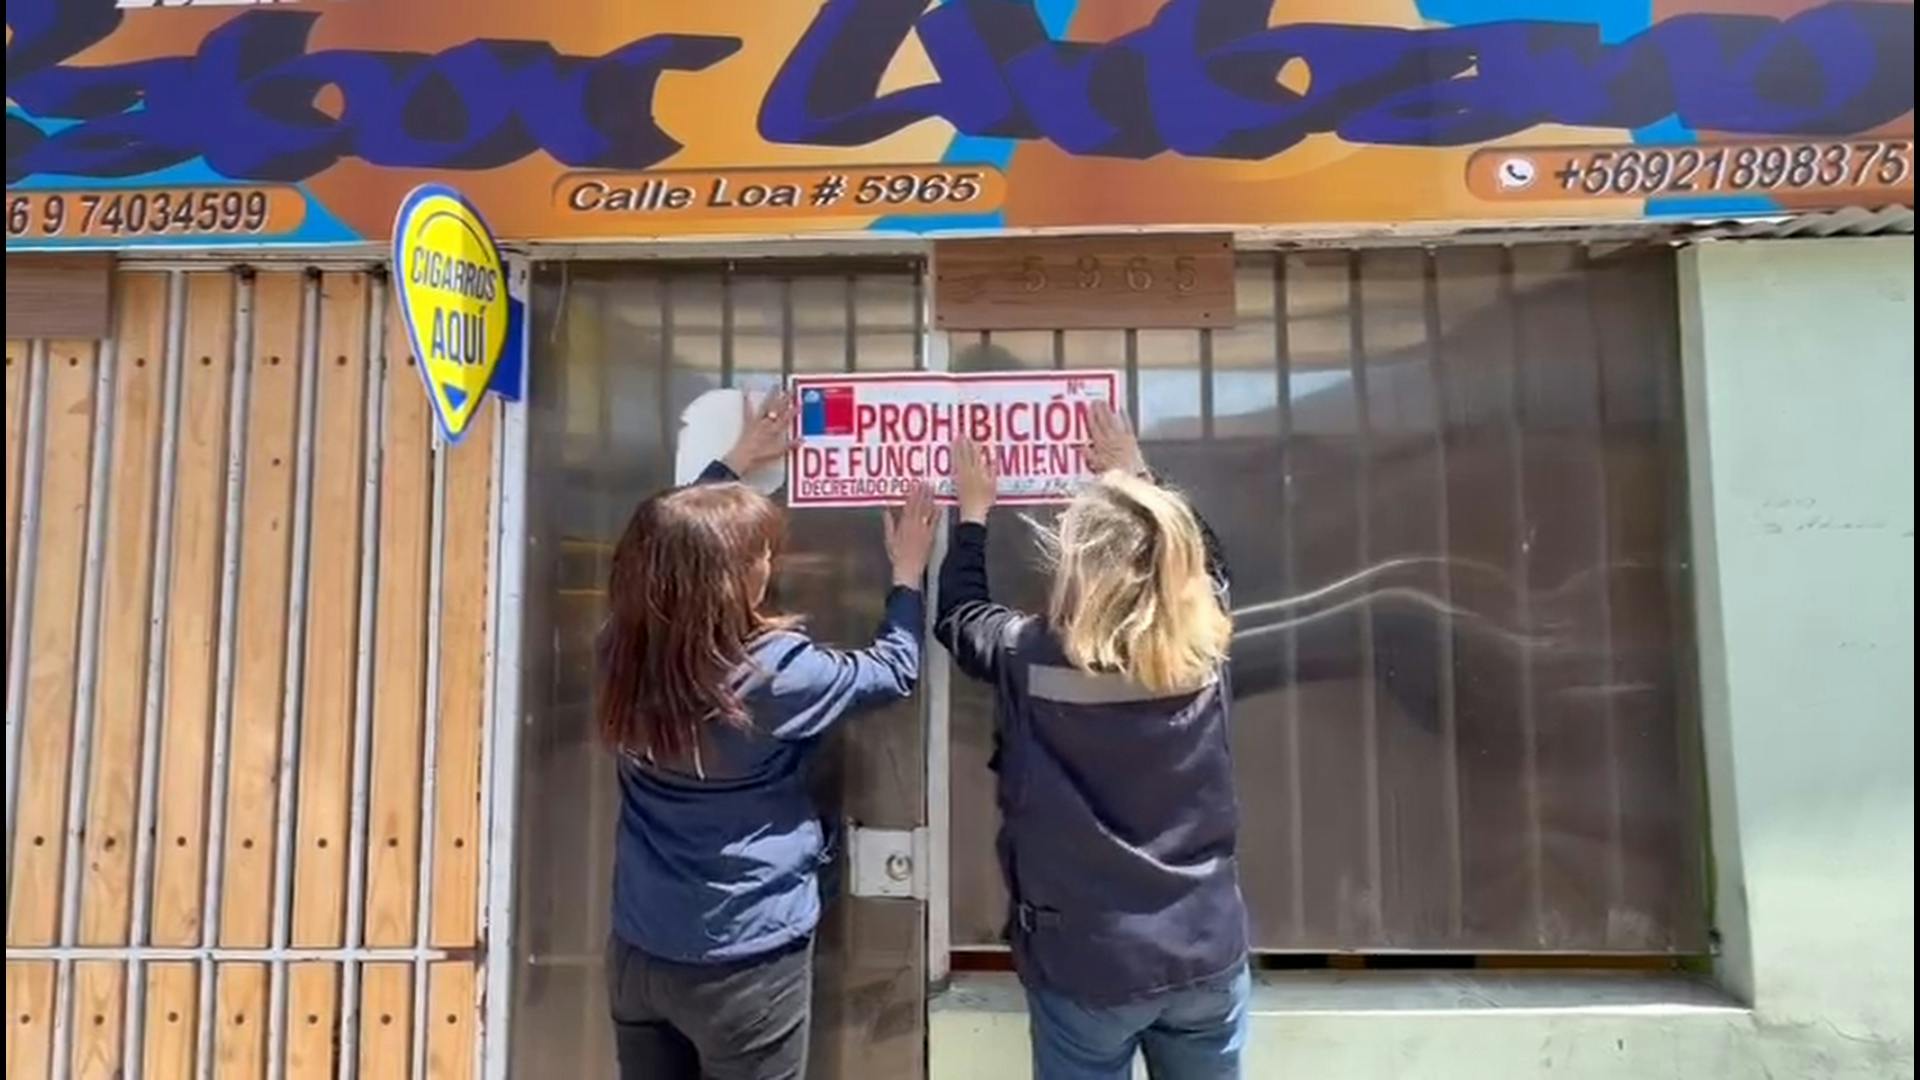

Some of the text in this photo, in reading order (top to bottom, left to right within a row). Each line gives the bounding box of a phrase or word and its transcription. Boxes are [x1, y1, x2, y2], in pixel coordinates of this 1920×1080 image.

[1554, 145, 1912, 196] +56921898375
[42, 195, 66, 236] 9
[78, 191, 268, 234] 74034599
[567, 173, 985, 214] Calle Loa # 5965
[411, 245, 499, 302] CIGARROS
[431, 305, 487, 365] AQUÍ
[803, 444, 1098, 477] DE FUNCIOAMIENT
[802, 479, 888, 496] DECRETADO
